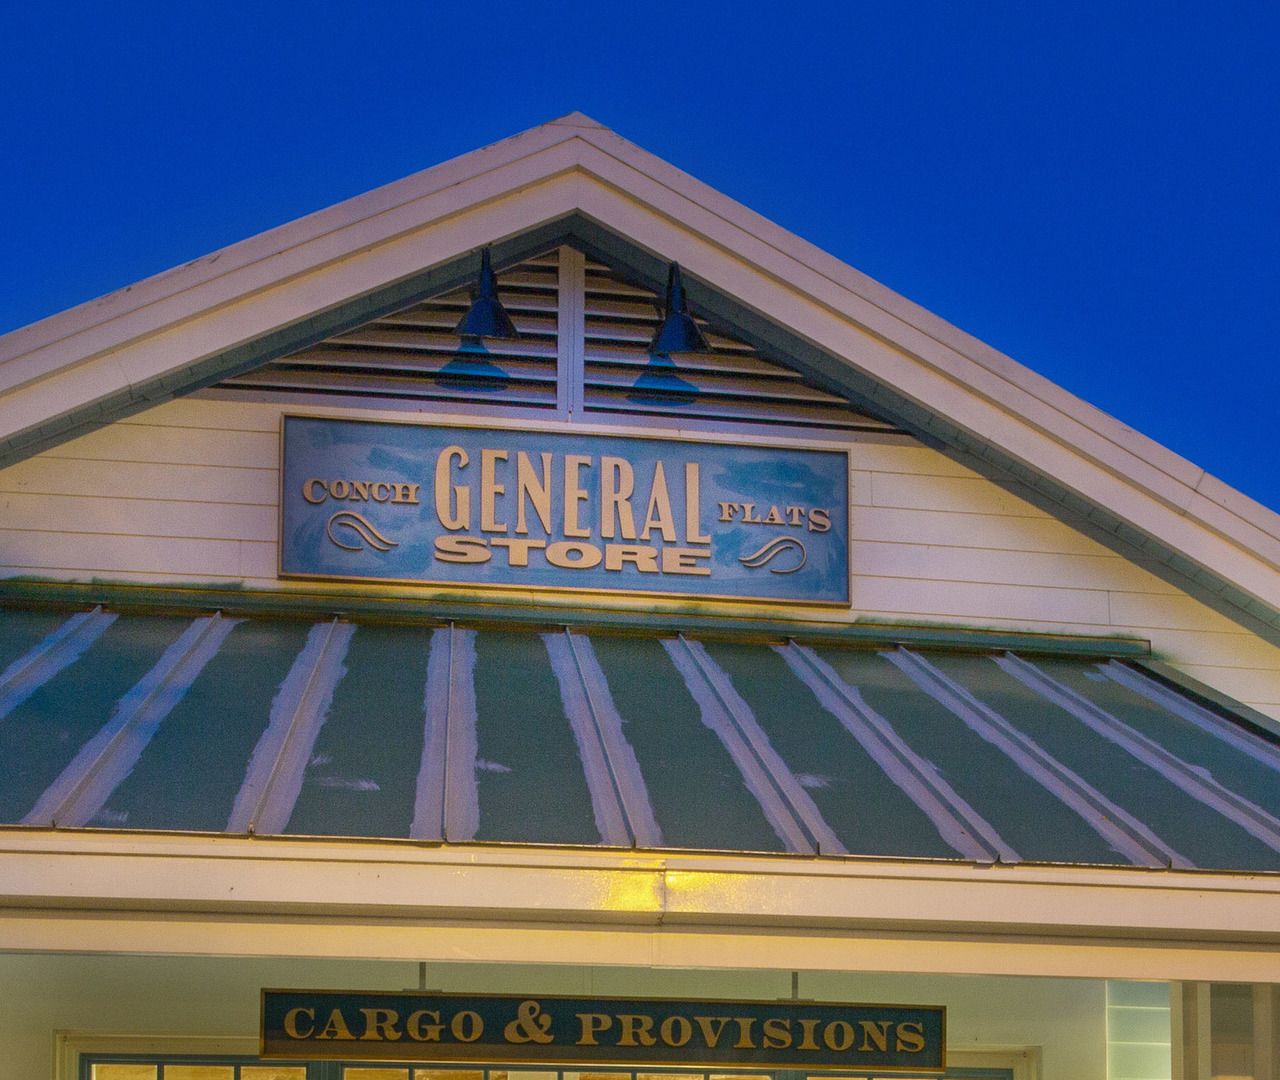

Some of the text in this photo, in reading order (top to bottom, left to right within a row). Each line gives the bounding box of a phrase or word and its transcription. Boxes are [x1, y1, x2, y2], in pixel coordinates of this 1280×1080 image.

[302, 478, 420, 505] CONCH
[434, 445, 712, 544] GENERAL
[718, 502, 832, 533] FLATS
[434, 535, 712, 577] STORE
[283, 1000, 926, 1054] CARGO & PROVISIONS
